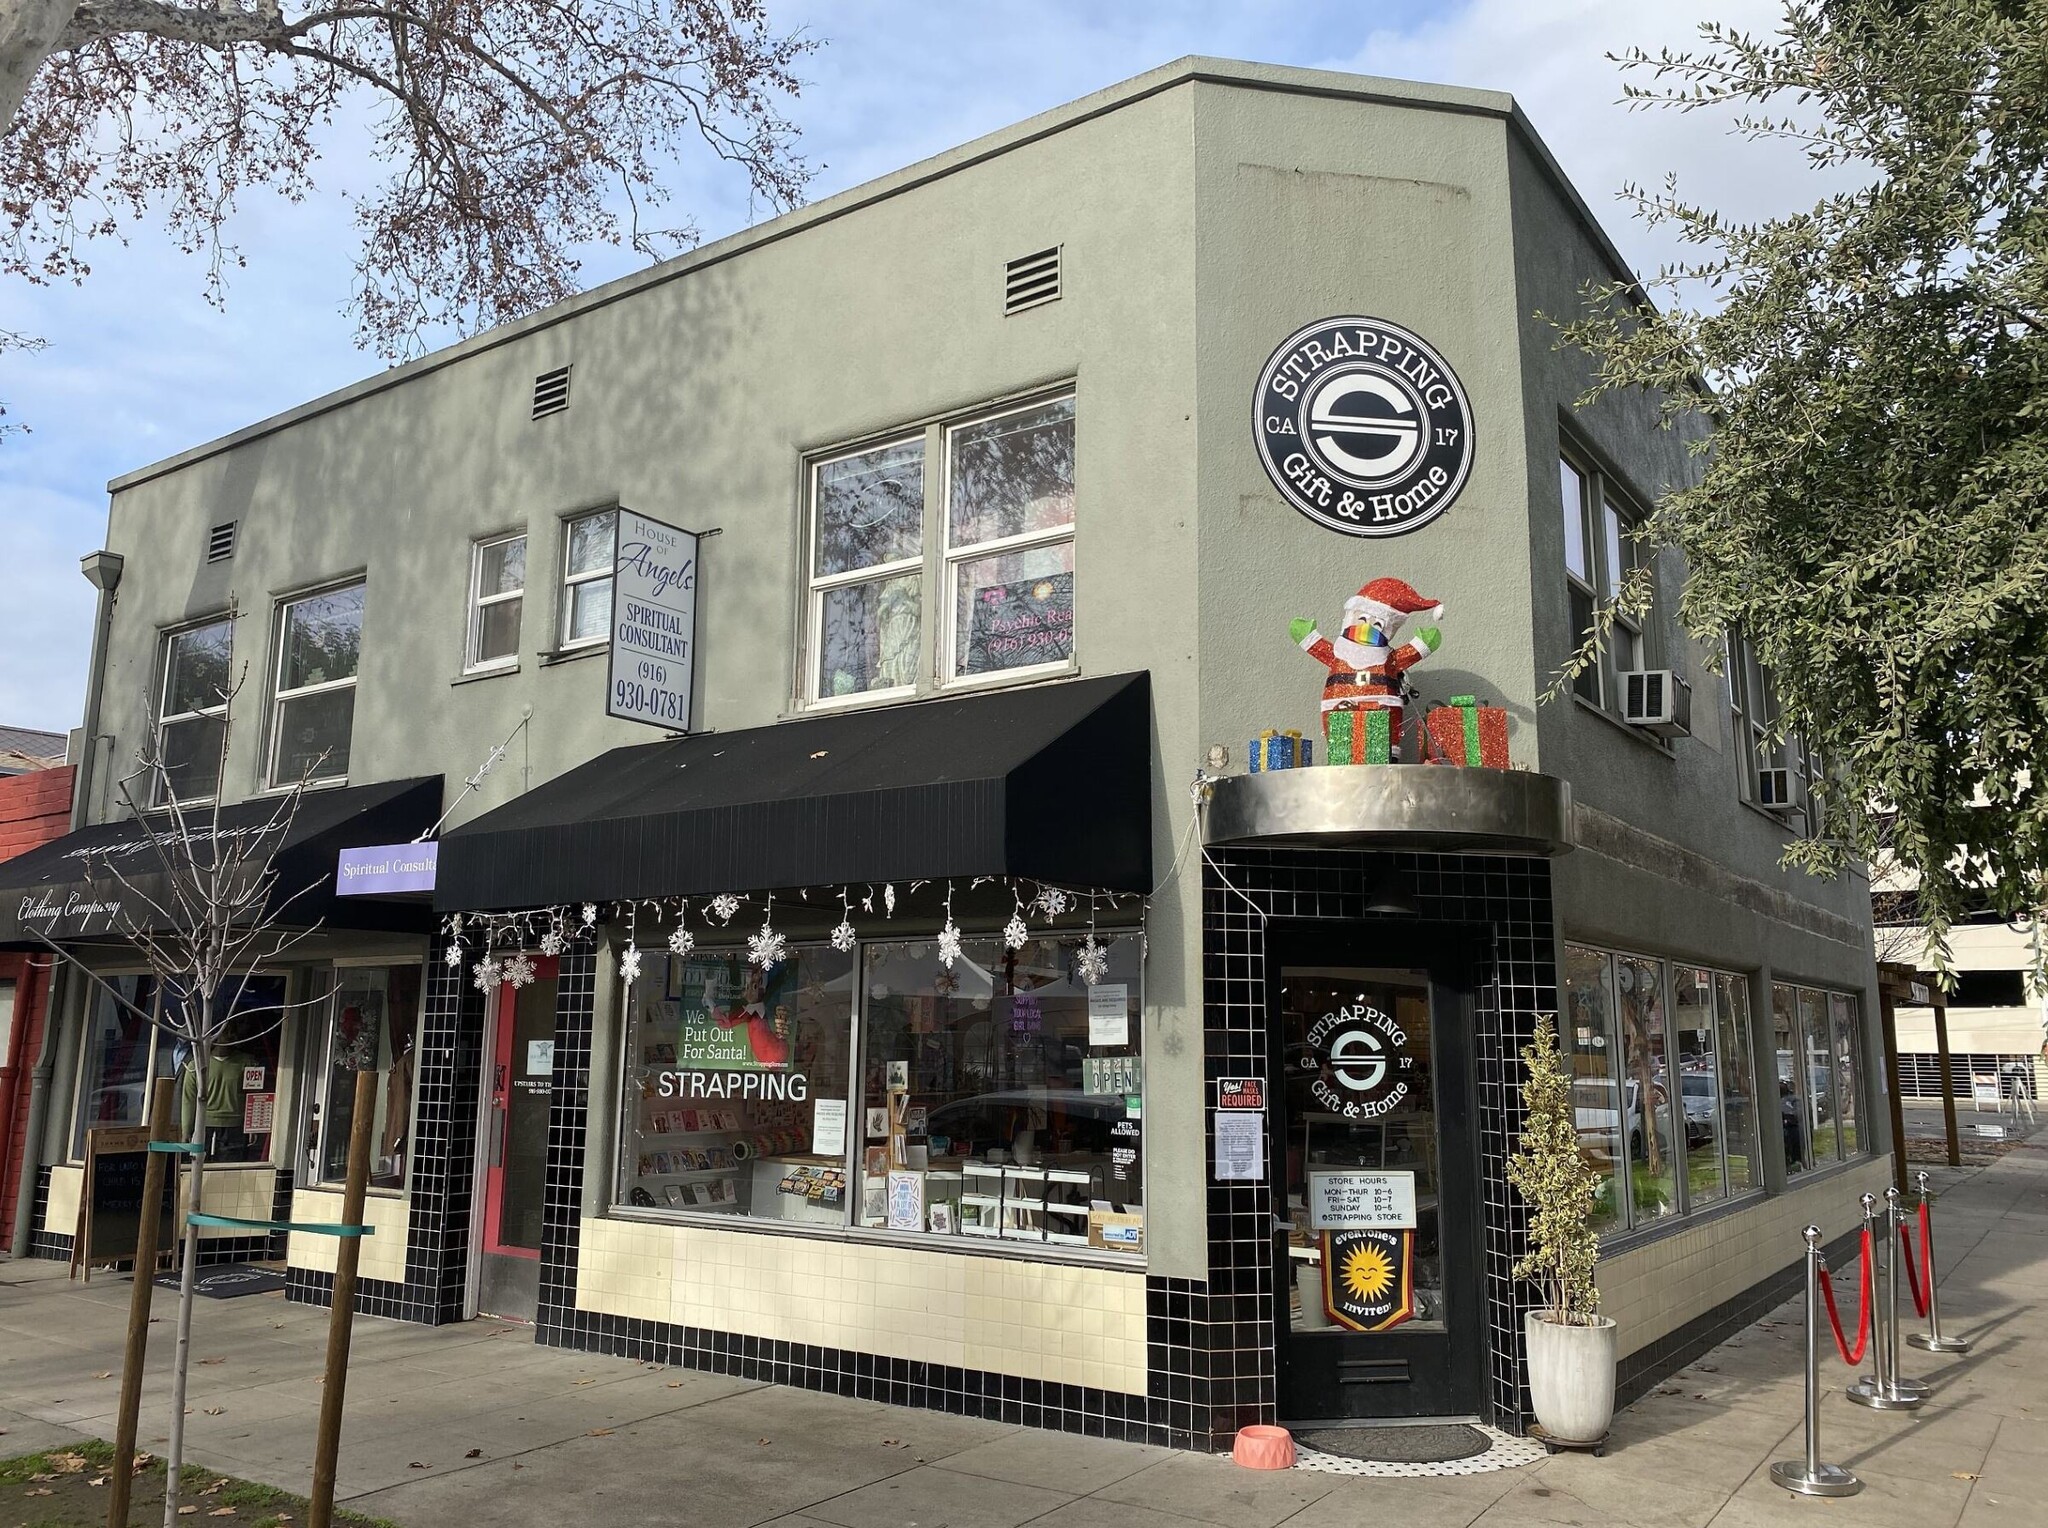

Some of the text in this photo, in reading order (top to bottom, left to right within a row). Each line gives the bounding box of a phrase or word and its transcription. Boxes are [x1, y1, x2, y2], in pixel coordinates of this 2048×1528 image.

[1272, 330, 1453, 410] STRAPPING
[1266, 416, 1297, 435] CA
[1435, 428, 1458, 446] 17
[1283, 453, 1448, 522] Gift & Home
[617, 542, 693, 597] Angels
[626, 603, 683, 636] SPIRITUAL
[991, 614, 1042, 635] Psychic
[619, 623, 688, 658] CONSULTANT
[638, 660, 667, 686] (916)
[616, 679, 684, 721] 930-0781
[343, 861, 389, 879] Spiritual
[18, 888, 121, 935] Clothing Company
[686, 1010, 705, 1024] We
[1307, 1004, 1408, 1048] STRAPPING
[685, 1027, 734, 1042] Put Out
[683, 1044, 747, 1060] For Santa!
[1300, 1057, 1319, 1068] CA
[1399, 1057, 1413, 1068] 17
[246, 1070, 263, 1081] OPEN
[1093, 1071, 1132, 1088] OPEN
[1244, 1080, 1257, 1088] FACE
[658, 1071, 807, 1101] STRAPPING
[1223, 1080, 1243, 1094] Yes!
[1243, 1087, 1259, 1095] MASKS
[1221, 1094, 1262, 1107] REQUIRED
[1311, 1080, 1408, 1119] Gift & Home
[1110, 1127, 1140, 1136] ALLOWED
[1117, 1121, 1133, 1129] PETS
[1328, 1177, 1354, 1185] STORE
